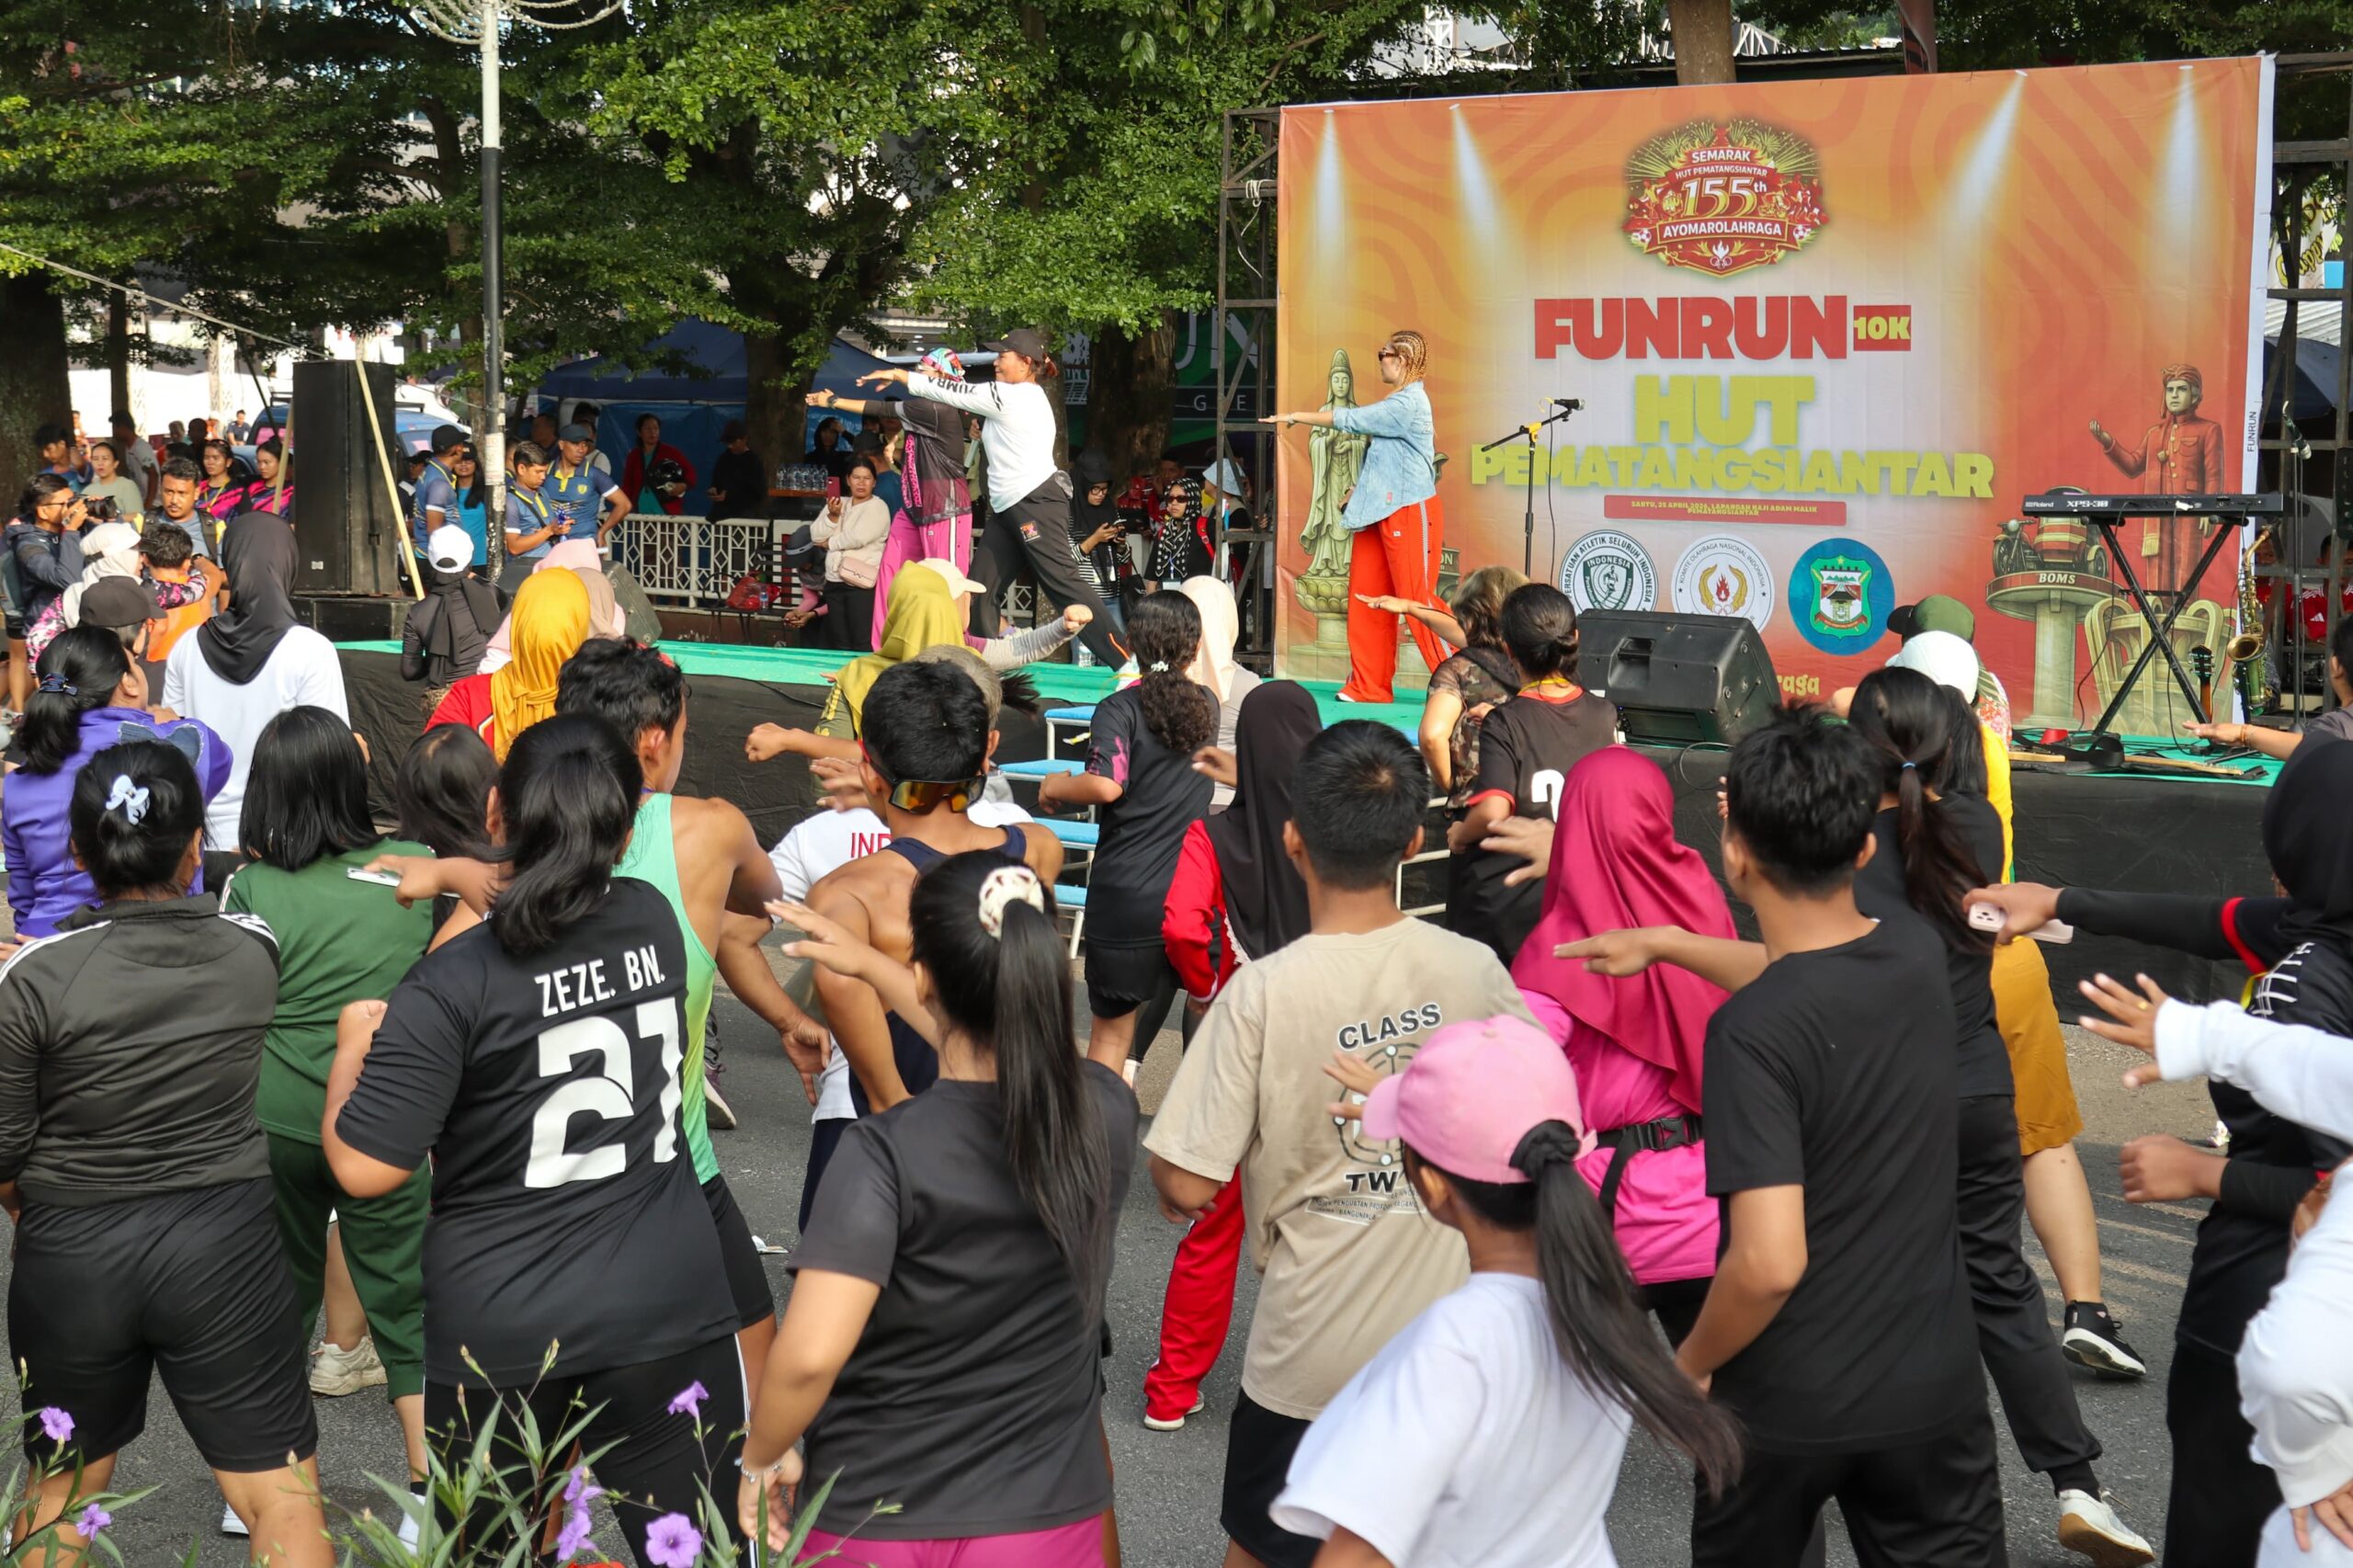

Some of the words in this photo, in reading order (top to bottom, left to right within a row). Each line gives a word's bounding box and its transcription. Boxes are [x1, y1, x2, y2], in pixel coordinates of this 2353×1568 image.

[1675, 169, 1692, 179] HUT
[1693, 165, 1768, 177] PEMATANGSIANTAR
[1691, 149, 1751, 164] SEMARAK
[1662, 220, 1782, 239] AYOMAROLAHRAGA
[1534, 295, 1847, 360] FUNRUN
[1854, 315, 1911, 341] 10K
[1635, 374, 1815, 447] HUT
[2246, 411, 2257, 452] FUNRUN
[1471, 443, 1995, 498] PEMATANGSIANTAR
[2066, 500, 2109, 508] XPS-30
[1564, 551, 1581, 598] ERSATUAN
[1579, 537, 1607, 553] ATLETIK
[1608, 537, 1641, 559] SELURUH
[1638, 558, 1653, 603] INDONESIA
[1586, 556, 1631, 569] INDONESIA
[1719, 542, 1746, 558] NASIONAL
[2038, 573, 2076, 585] BOMS
[534, 959, 617, 1017] ZEZE.
[623, 944, 666, 992] BN.
[1337, 1002, 1443, 1051] CLASS
[524, 995, 685, 1188] 21
